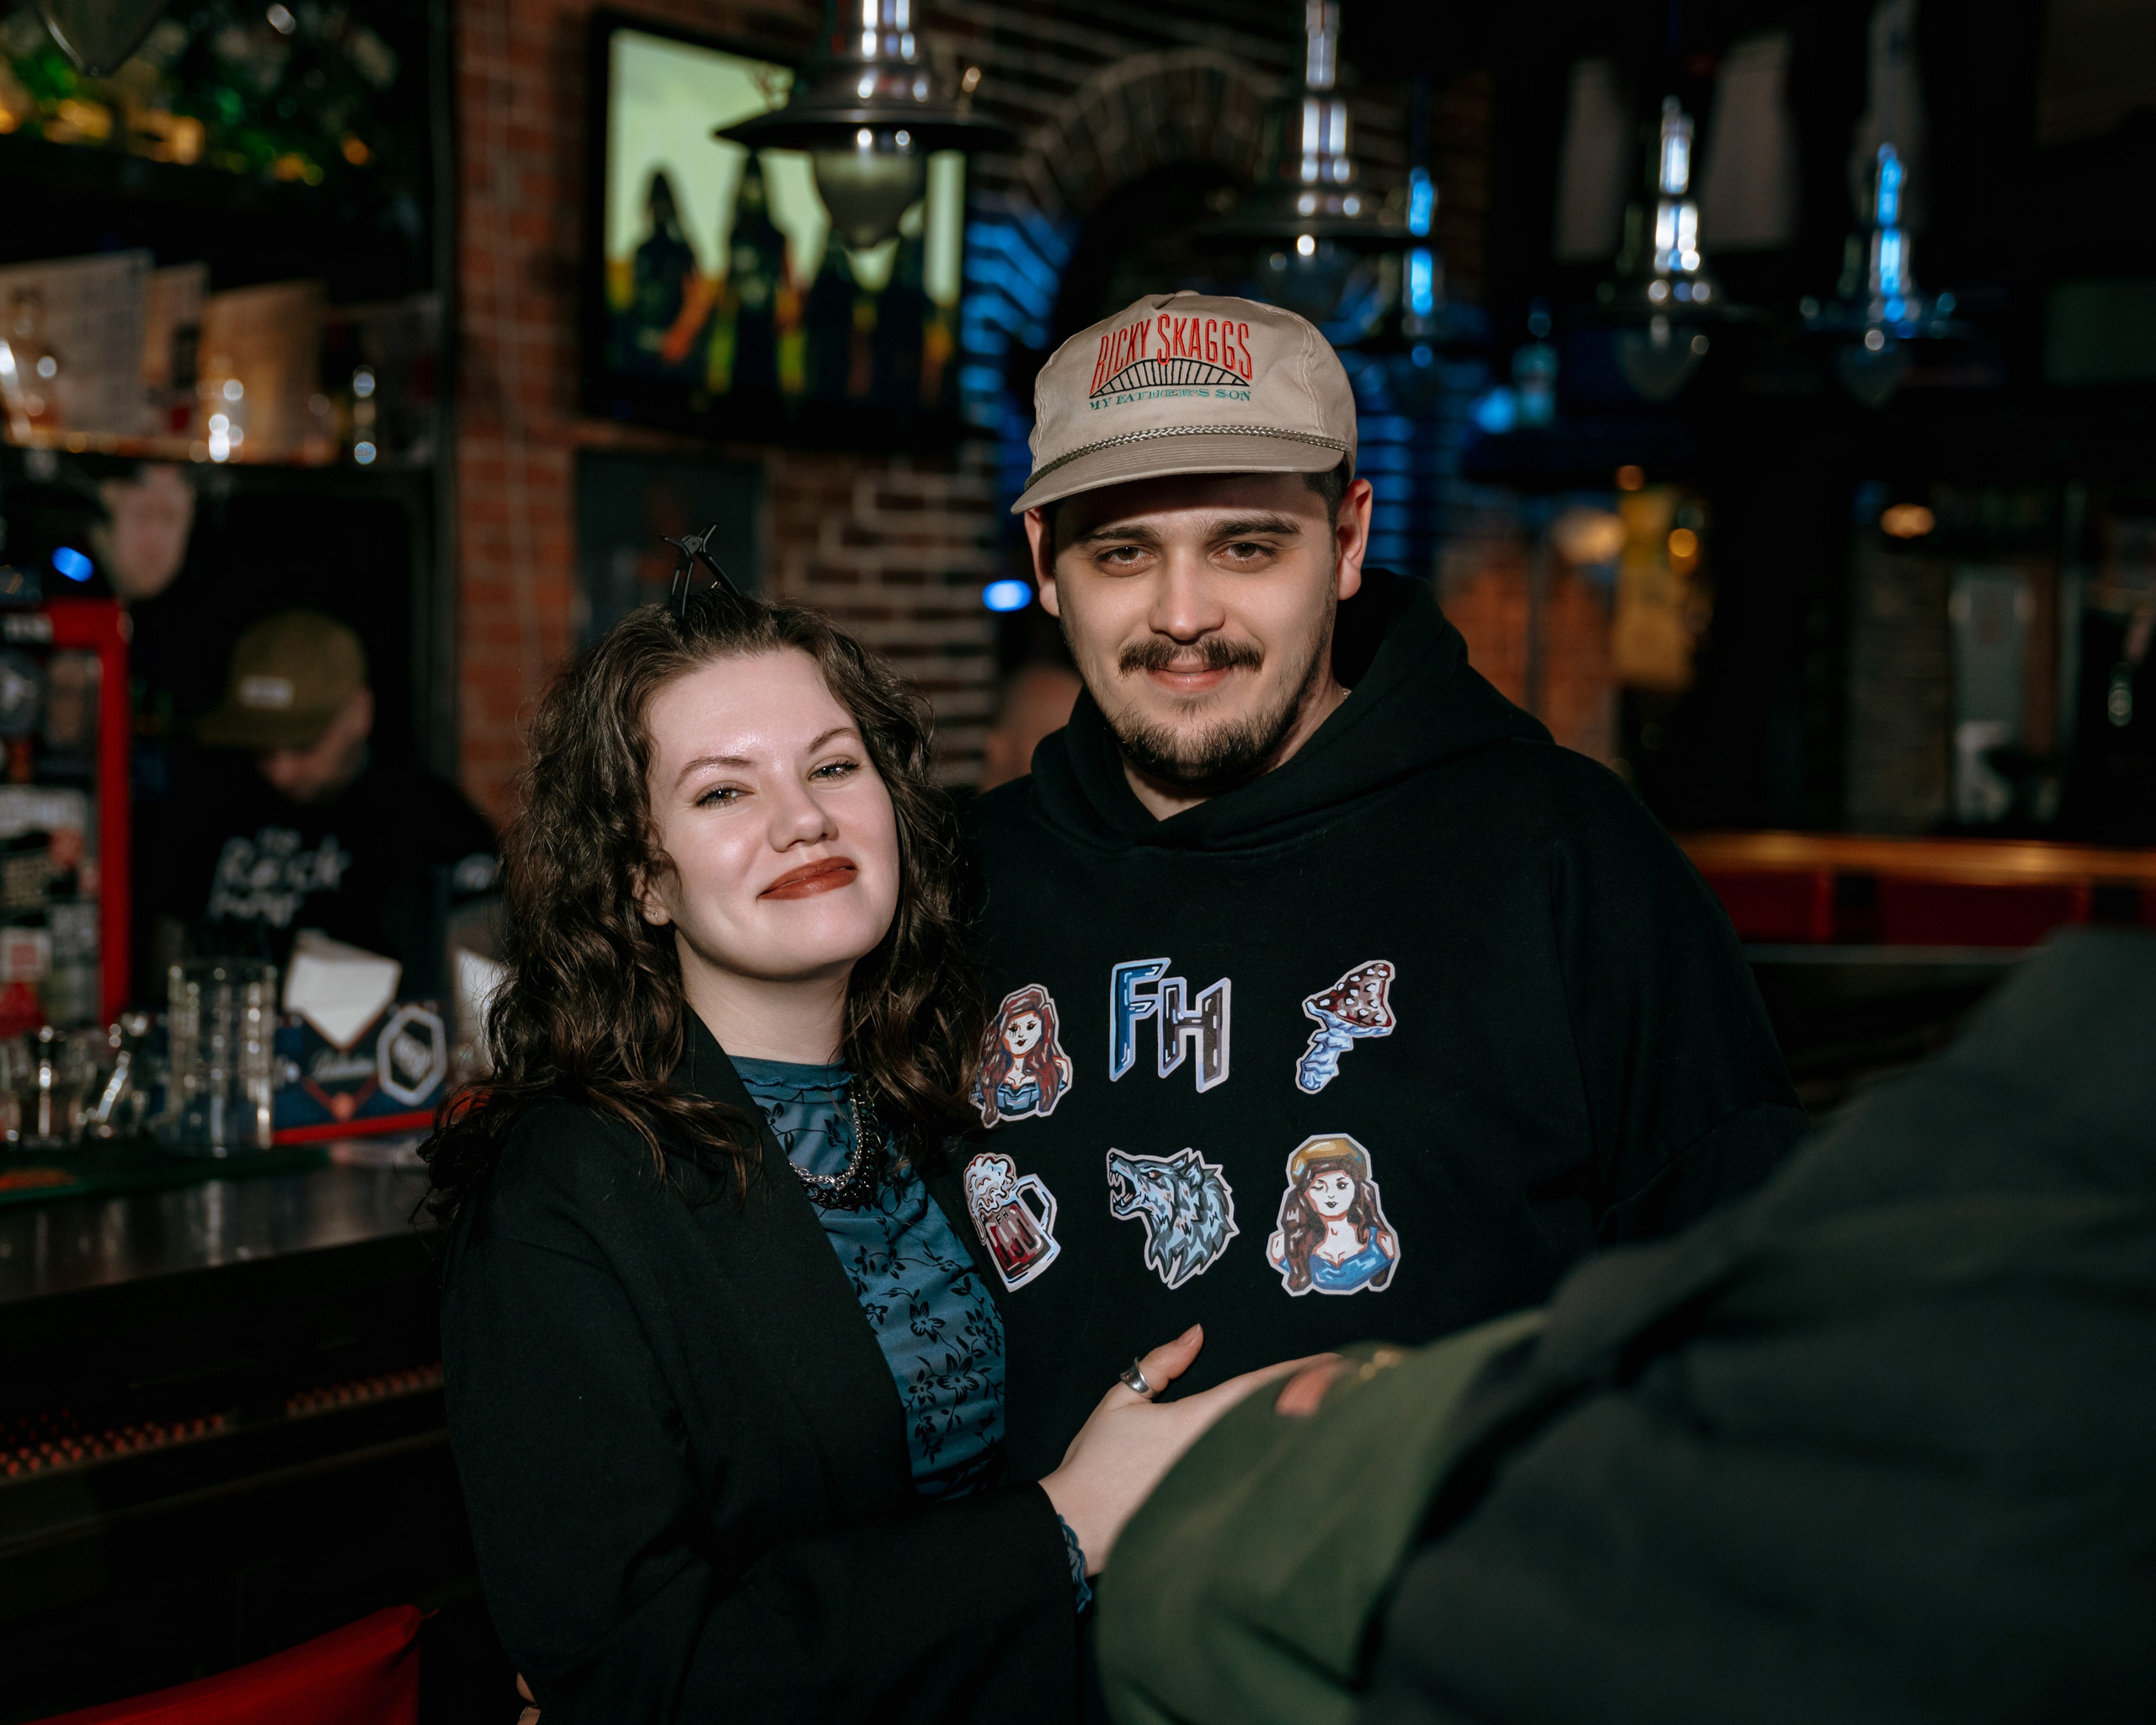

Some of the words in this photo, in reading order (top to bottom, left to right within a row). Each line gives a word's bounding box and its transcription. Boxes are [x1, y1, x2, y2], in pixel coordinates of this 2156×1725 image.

[1090, 319, 1151, 395] RICKY
[1157, 314, 1252, 380] SKAGGS
[1090, 398, 1113, 410] MY
[1116, 388, 1209, 405] FATHER'S
[1214, 388, 1251, 402] SON
[1109, 957, 1231, 1093] FH
